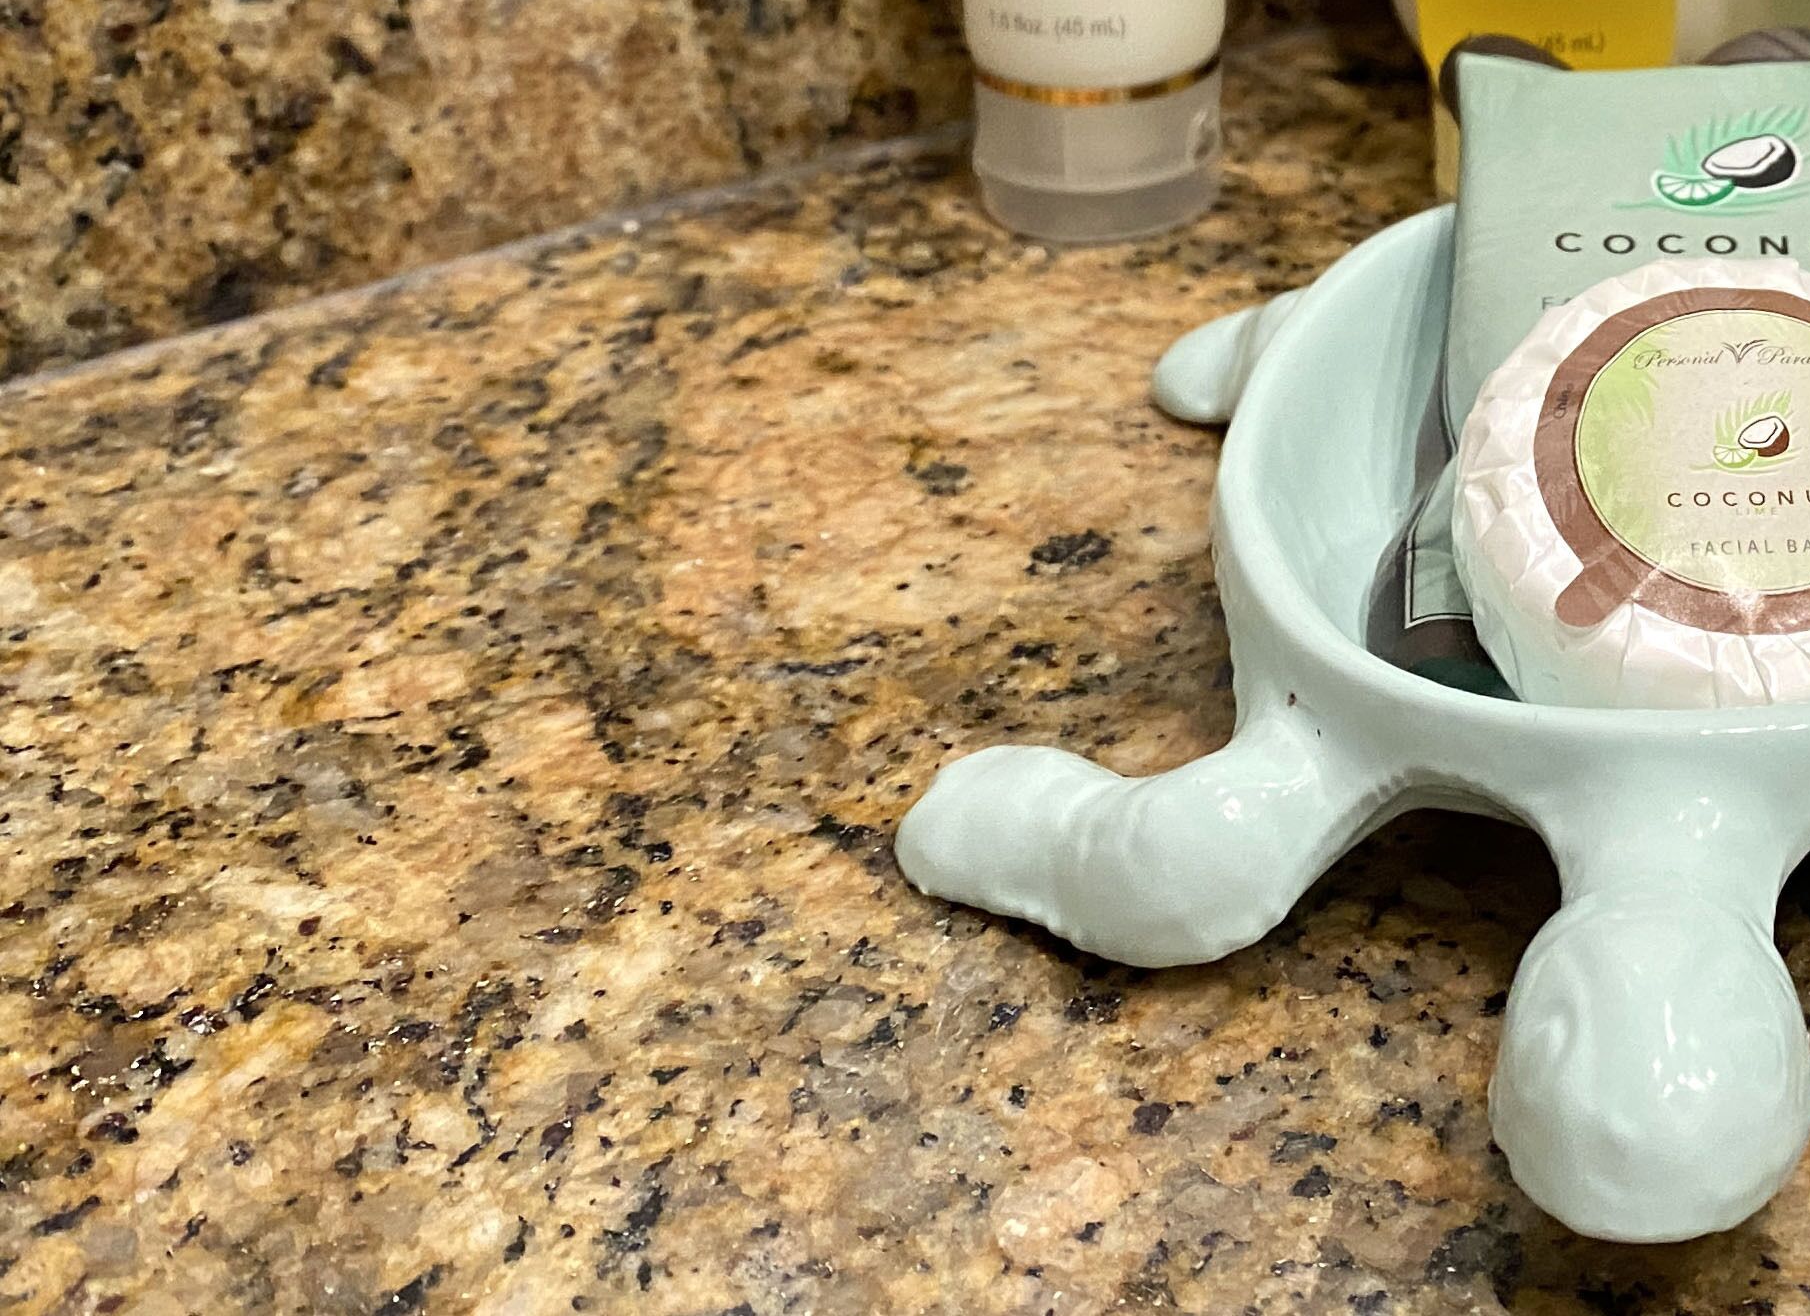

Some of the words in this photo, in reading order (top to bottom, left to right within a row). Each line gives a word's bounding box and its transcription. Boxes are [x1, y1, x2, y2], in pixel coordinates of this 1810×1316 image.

[1633, 348, 1725, 370] Personal
[1735, 507, 1778, 516] LIME
[1691, 540, 1774, 557] FACIAL
